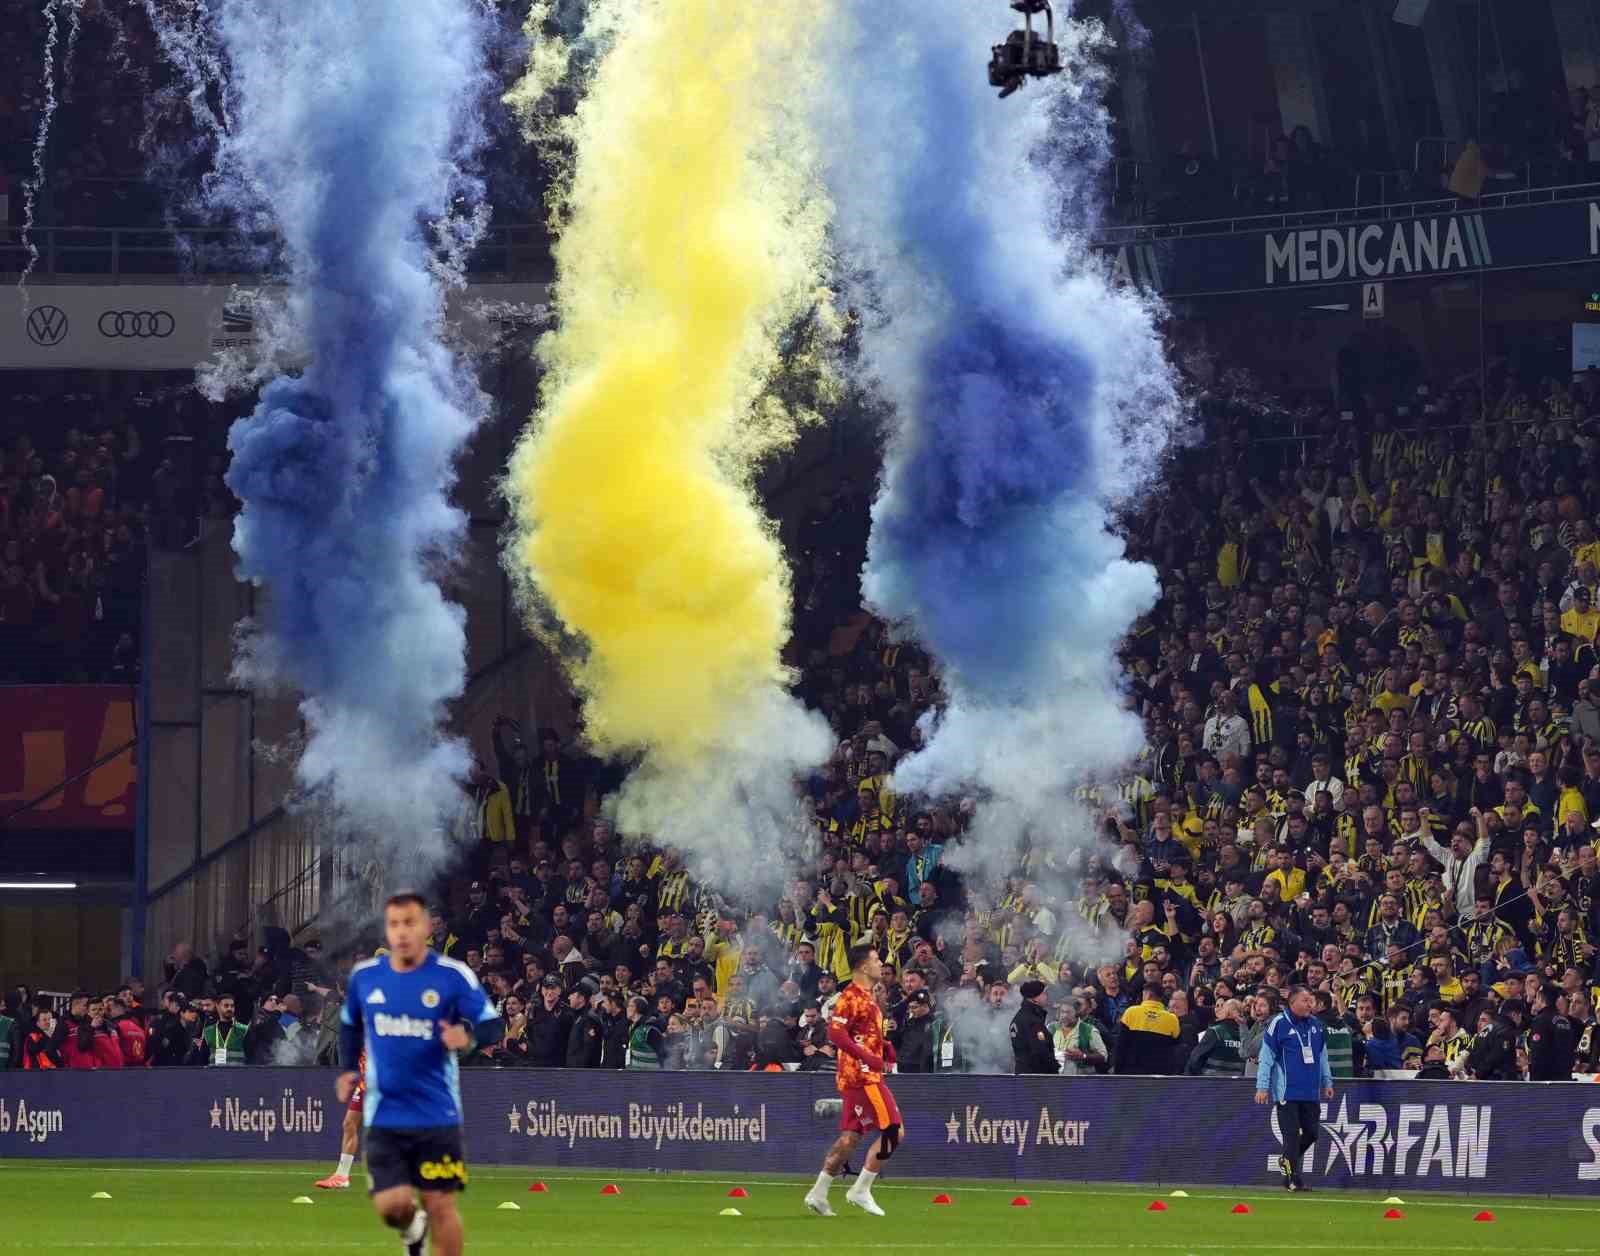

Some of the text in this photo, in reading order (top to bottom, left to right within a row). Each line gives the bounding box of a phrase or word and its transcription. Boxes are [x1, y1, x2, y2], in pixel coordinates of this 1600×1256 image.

[1265, 217, 1467, 284] MEDICANA
[1367, 286, 1378, 307] A
[16, 1099, 63, 1143] Aşgın
[225, 1088, 323, 1142] Necip Ünlü
[526, 1100, 766, 1150] Süleyman Büyükdemirel
[966, 1105, 1090, 1155] Koray Acar
